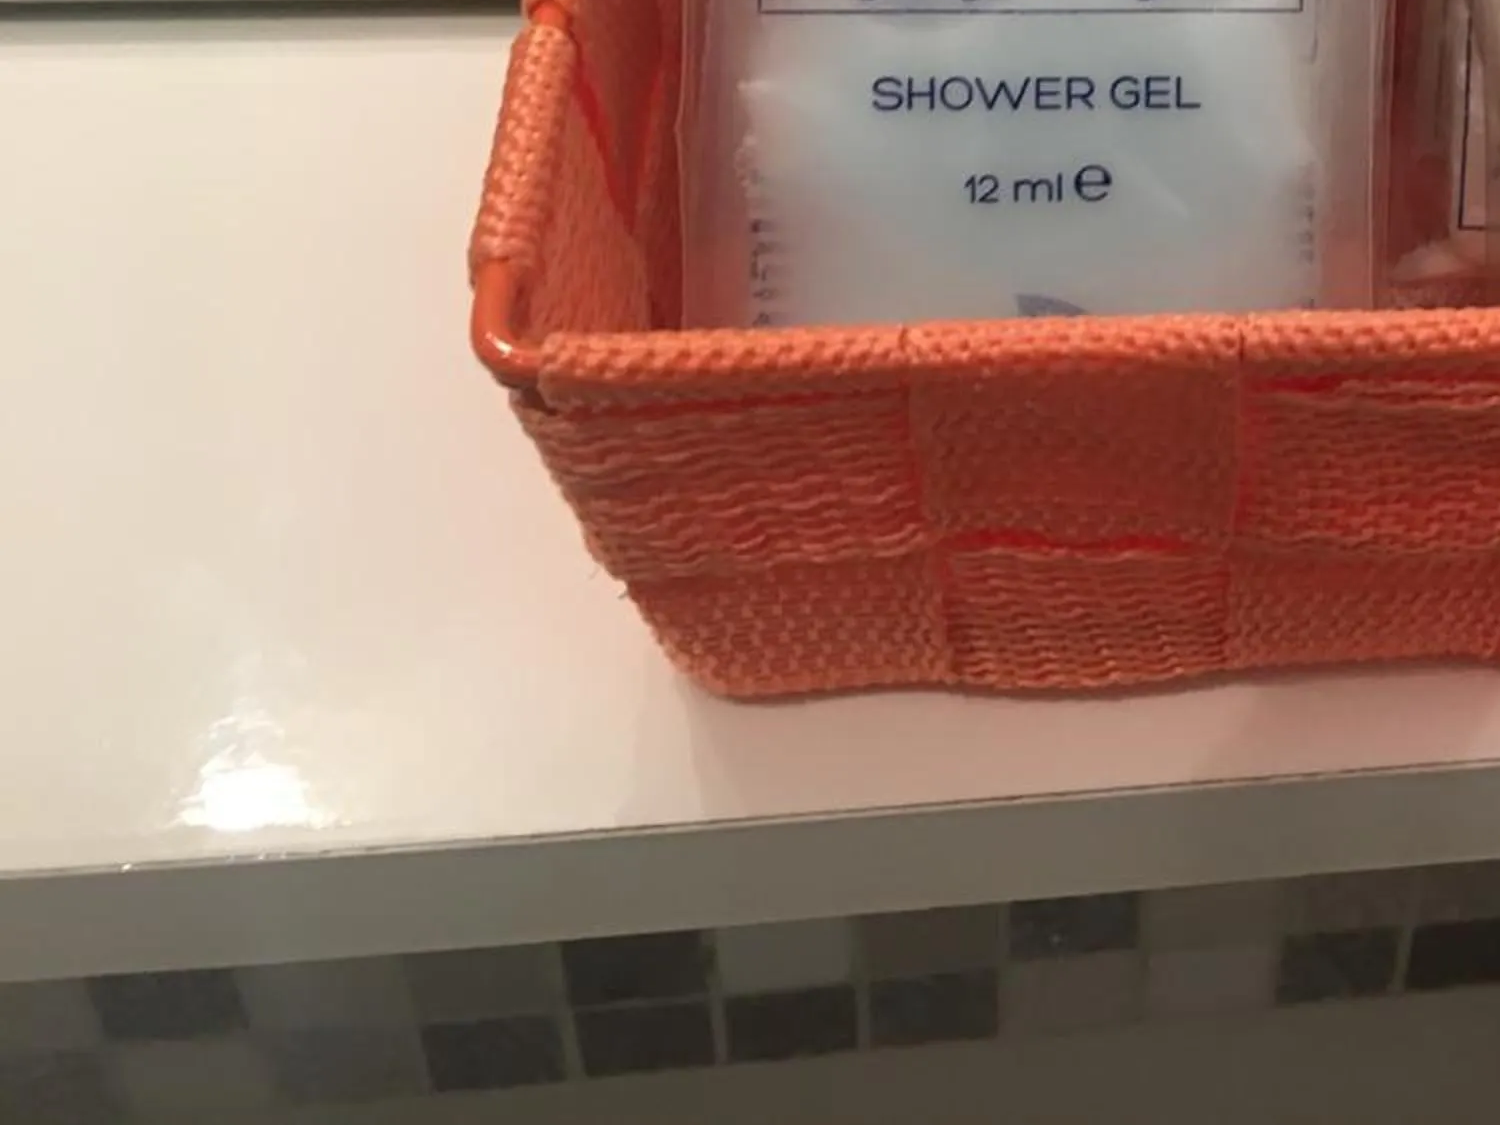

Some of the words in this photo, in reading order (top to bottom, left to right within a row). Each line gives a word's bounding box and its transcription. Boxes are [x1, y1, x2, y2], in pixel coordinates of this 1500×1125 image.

[871, 75, 1097, 112] SHOWER
[1109, 75, 1202, 111] GEL
[963, 175, 1000, 204] 12
[1012, 172, 1064, 204] ml
